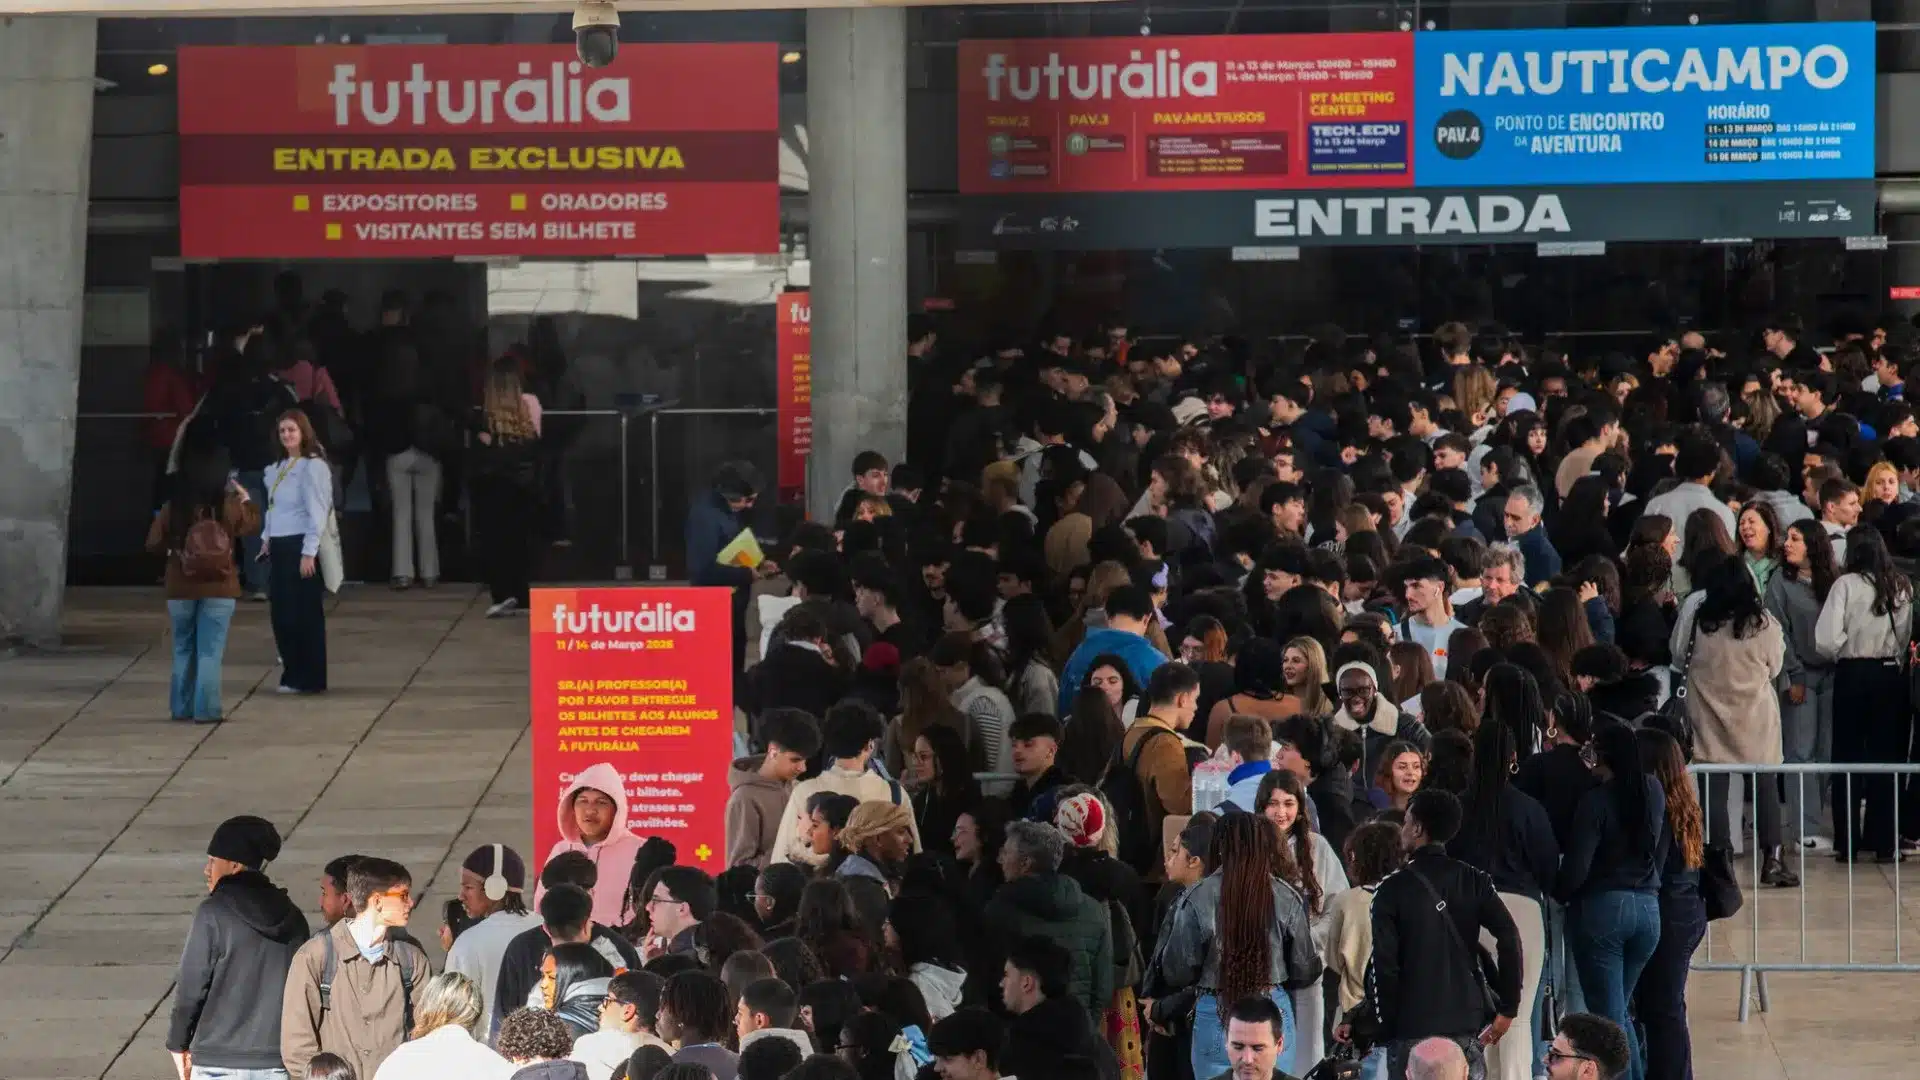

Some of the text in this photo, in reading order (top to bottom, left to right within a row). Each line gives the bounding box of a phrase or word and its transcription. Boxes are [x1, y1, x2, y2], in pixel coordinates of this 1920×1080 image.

[1440, 44, 1849, 96] NAUTICAMPO
[1240, 72, 1255, 82] de
[1310, 91, 1395, 103] PT MEETING
[1310, 104, 1366, 116] CENTER
[1708, 101, 1770, 120] HORÁRIO
[1495, 111, 1664, 132] PONTO DE ENCONTRO
[1312, 124, 1400, 136] TECH.EDU
[1437, 126, 1480, 144] PAV.4
[1734, 124, 1744, 133] DE
[1745, 123, 1773, 135] MARÇO
[1343, 137, 1355, 146] de
[1356, 137, 1386, 148] Março
[1514, 134, 1622, 154] DA AVENTURA
[1719, 138, 1729, 147] DE
[1730, 138, 1758, 148] MARÇO
[273, 146, 685, 171] ENTRADA EXCLUSIVA
[1719, 152, 1729, 161] DE
[1730, 151, 1758, 162] MARÇO
[323, 194, 478, 211] EXPOSITORES
[541, 193, 668, 211] ORADORES
[1254, 195, 1571, 236] ENTRADA
[355, 222, 635, 240] VISITANTES SEM BILHETE
[552, 603, 696, 634] futurália
[556, 640, 565, 650] 11
[576, 640, 588, 649] 14
[591, 640, 605, 649] de
[608, 639, 643, 652] Março
[646, 640, 674, 649] 2026
[557, 679, 687, 692] SR.(A) PROFESSOR(A)
[558, 694, 696, 706] POR FAVOR ENTREGUE
[558, 710, 719, 721] OS BILHETES AOS ALUNOS
[558, 725, 690, 737] ANTES DE CHEGAREM
[558, 739, 640, 752] À FUTURÁLIA
[629, 772, 659, 782] deve
[661, 772, 704, 784] chegar
[637, 787, 683, 797] bilhete.
[678, 804, 695, 813] no
[628, 817, 688, 829] pavilhões.
